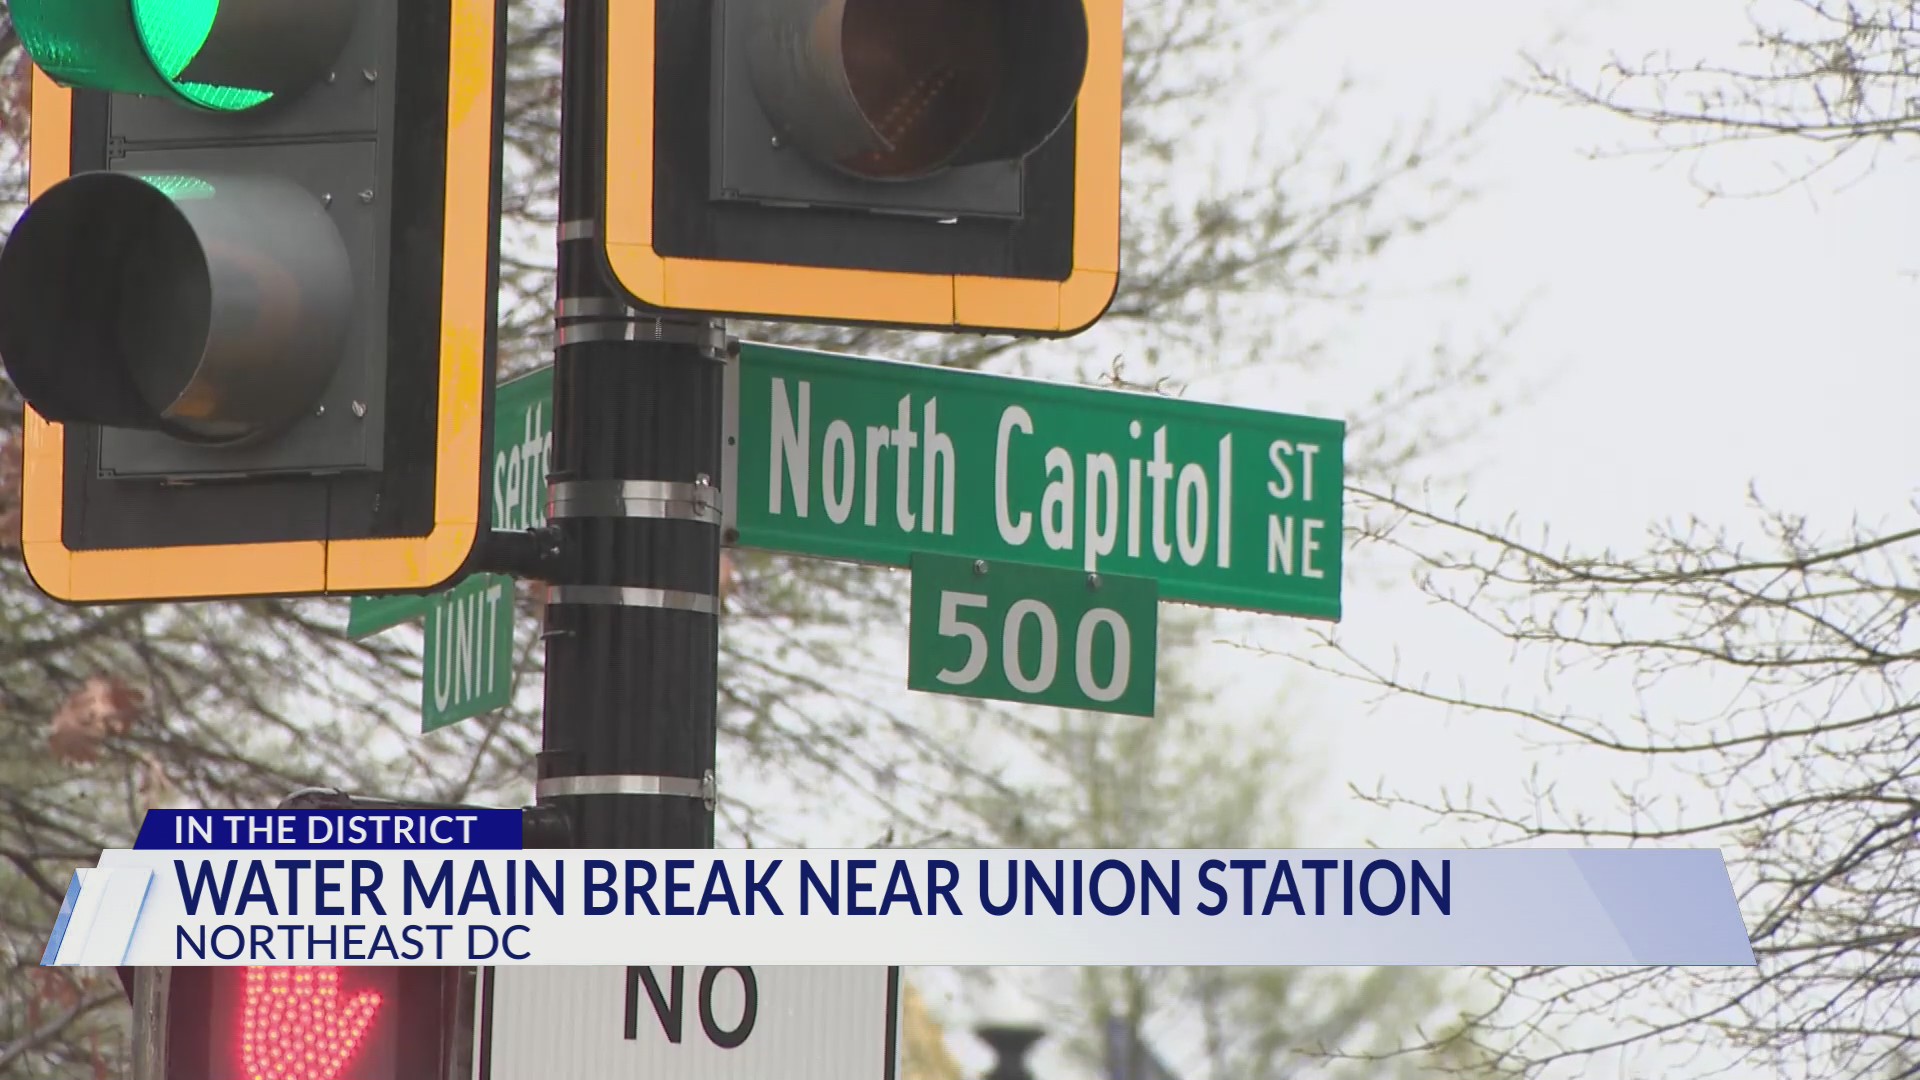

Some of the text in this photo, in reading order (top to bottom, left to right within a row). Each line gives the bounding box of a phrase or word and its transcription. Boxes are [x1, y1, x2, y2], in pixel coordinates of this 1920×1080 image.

[768, 377, 1232, 574] North Capitol
[1267, 440, 1320, 501] ST
[1267, 514, 1324, 579] NE
[434, 585, 502, 712] UNIT
[935, 590, 1131, 701] 500
[624, 965, 758, 1049] NO
